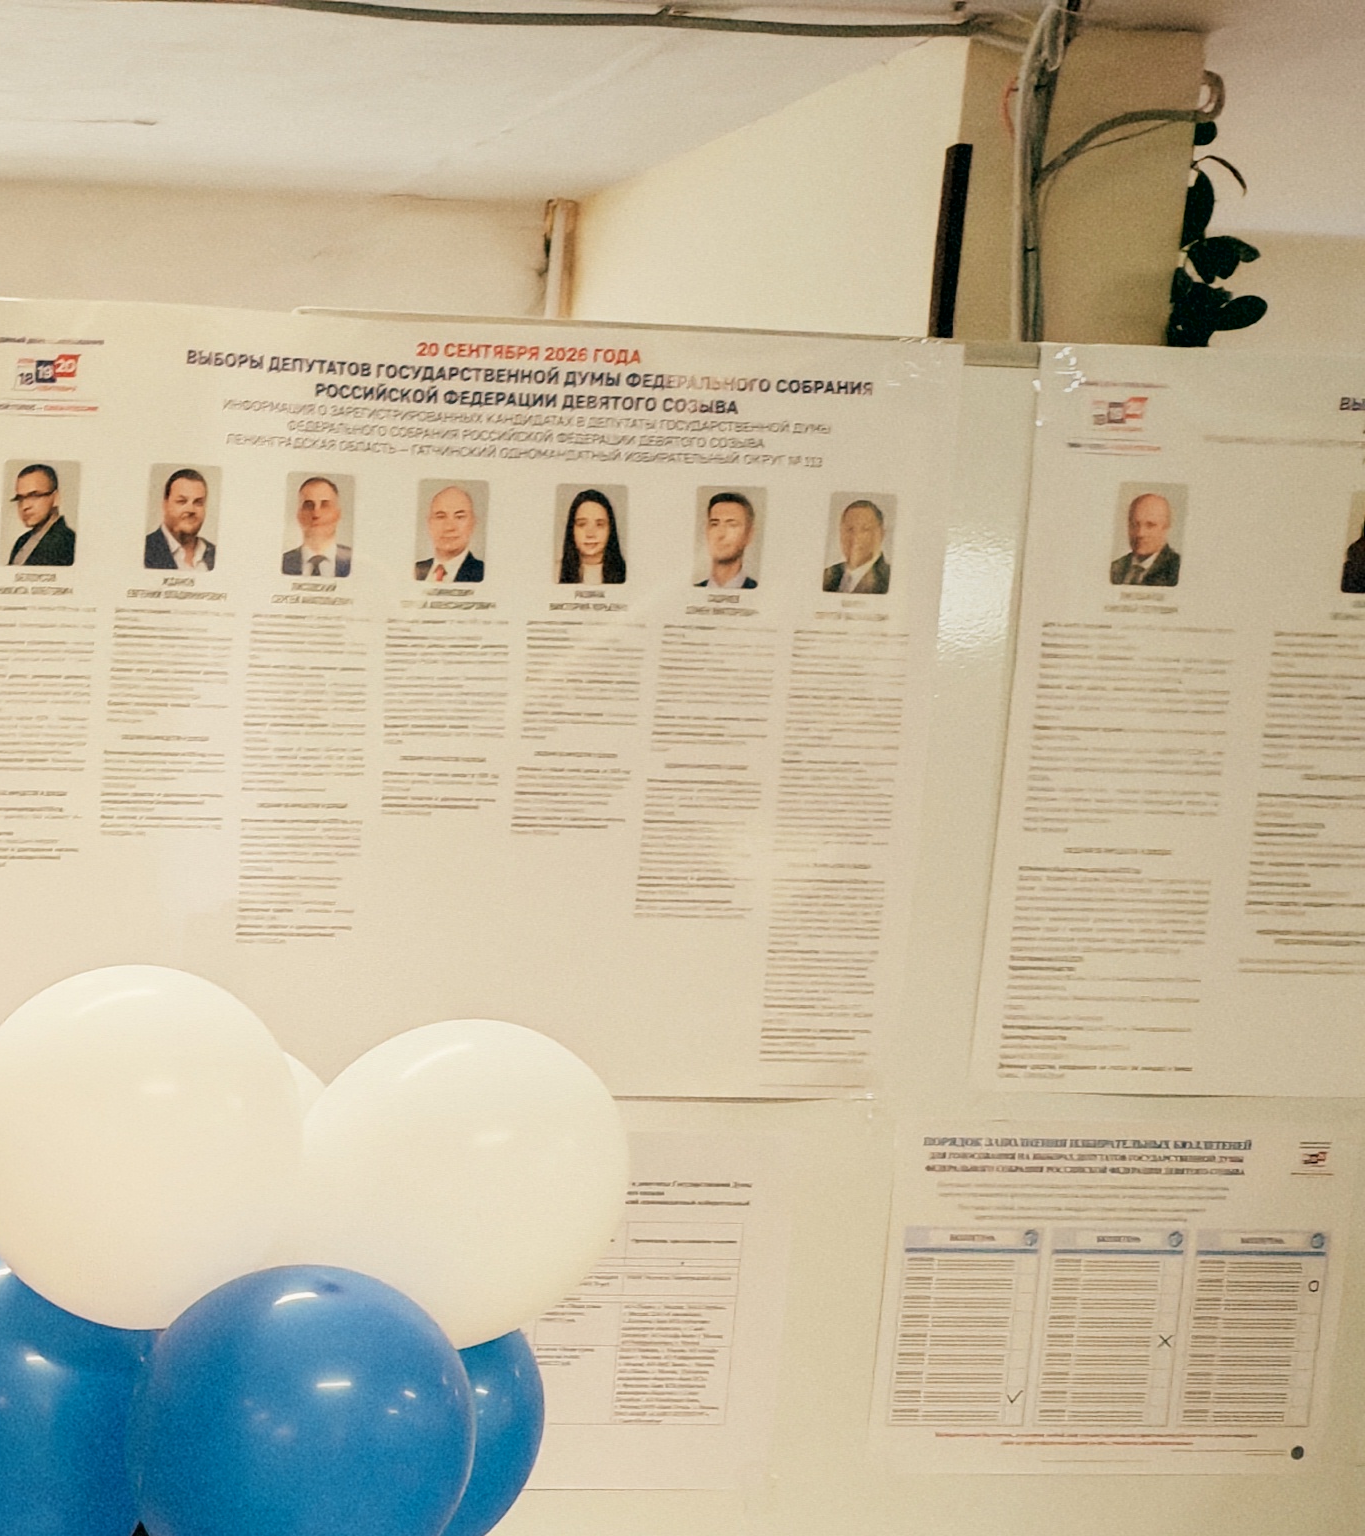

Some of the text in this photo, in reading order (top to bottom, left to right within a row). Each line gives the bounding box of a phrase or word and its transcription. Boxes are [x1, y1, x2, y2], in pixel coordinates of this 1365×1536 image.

[55, 360, 76, 373] 20
[417, 342, 641, 366] 20 СЕНТЯБРЯ 2026 ГОДА
[187, 349, 873, 395] ВЫБОРЫ ДЕПУТАТОВ ГОСУДАРСТВЕННОЙ ДУМЫ ФЕДЕРАЛЬНОГО СОБРАНИЯ
[315, 383, 738, 415] РОССИЙСКОЙ ФЕДЕРАЦИИ ДЕВЯТОГО СОЗЫВА
